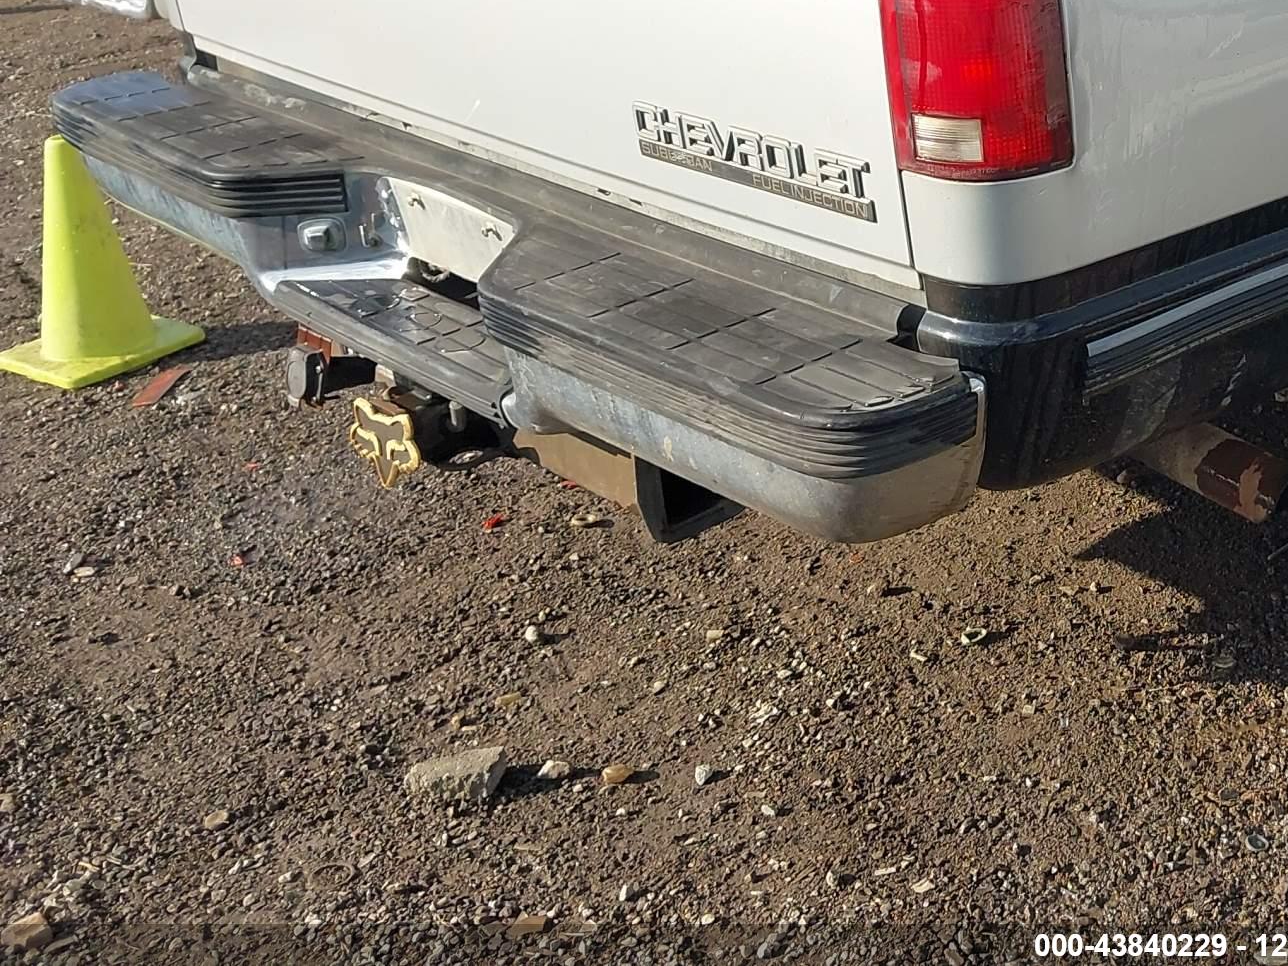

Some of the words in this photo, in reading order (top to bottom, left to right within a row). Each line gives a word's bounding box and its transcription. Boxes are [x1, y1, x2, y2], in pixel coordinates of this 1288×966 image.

[632, 100, 871, 200] CHEVROLET
[640, 141, 713, 172] SUBBAN
[752, 174, 789, 195] FUEL
[791, 184, 867, 218] INJECTION
